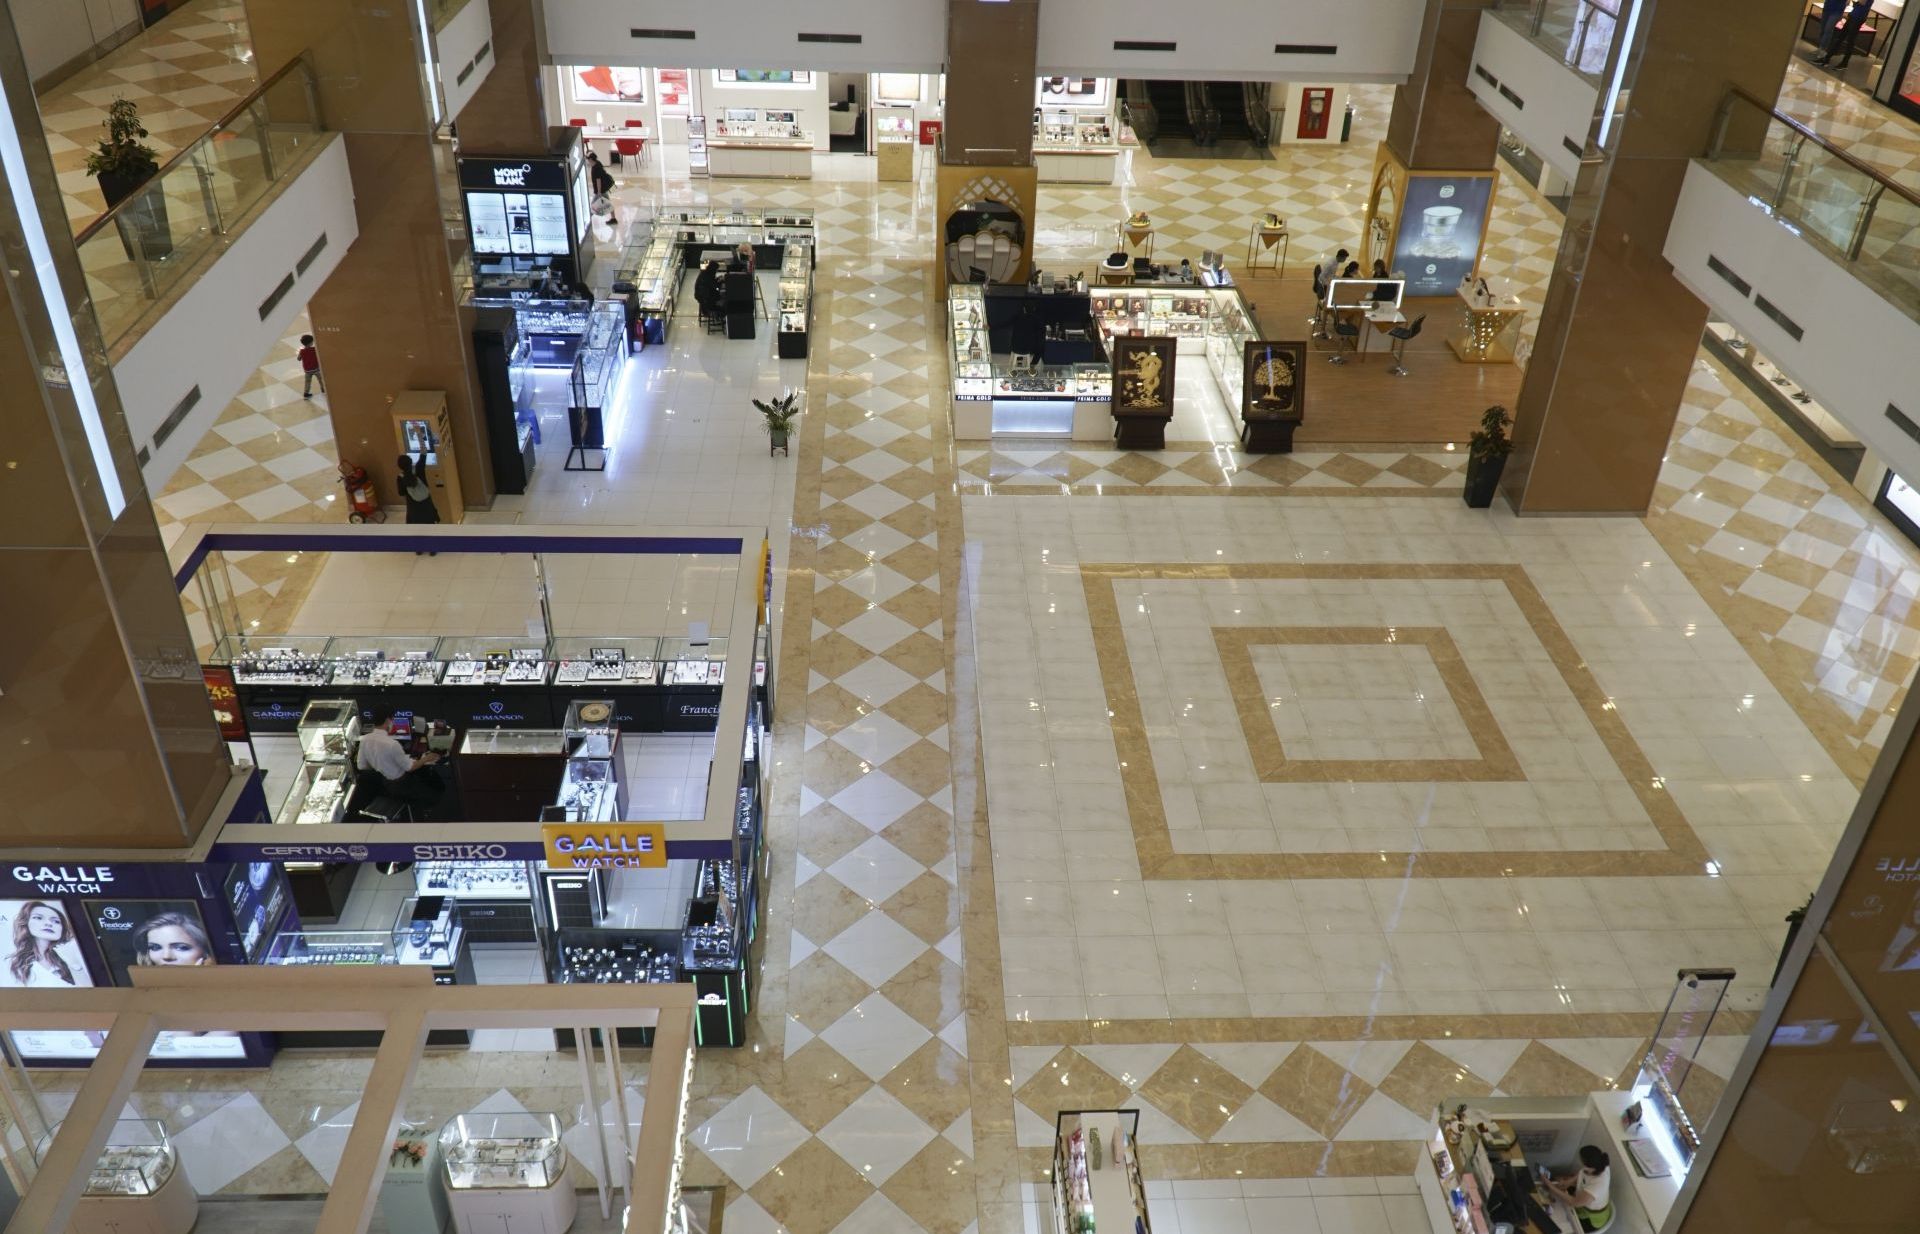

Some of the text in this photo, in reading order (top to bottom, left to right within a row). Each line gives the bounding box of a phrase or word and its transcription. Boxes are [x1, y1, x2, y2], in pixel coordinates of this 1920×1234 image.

[494, 168, 523, 177] MONT
[495, 176, 525, 186] BLANC
[554, 836, 653, 853] GALLE
[261, 846, 348, 855] CERTINA
[413, 844, 507, 860] SEIKO
[572, 857, 640, 868] WATCH
[12, 866, 115, 882] GALLE
[37, 883, 101, 894] WATCH
